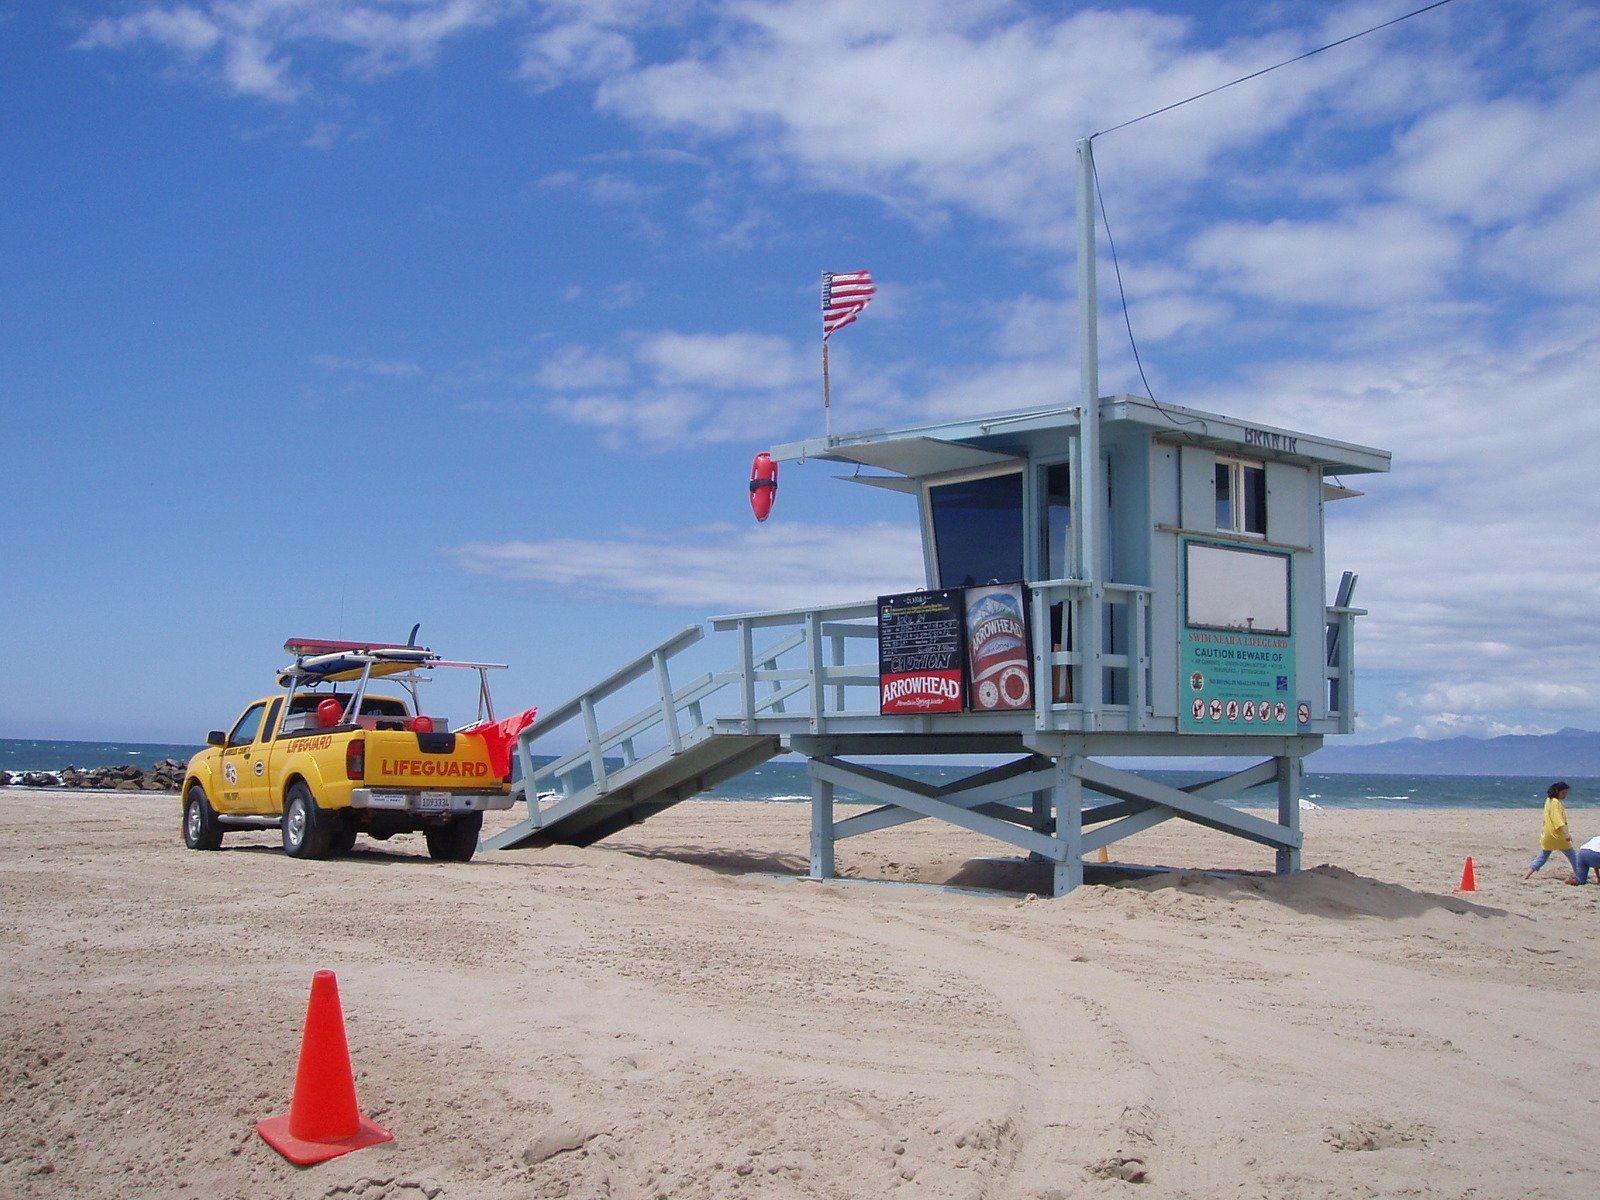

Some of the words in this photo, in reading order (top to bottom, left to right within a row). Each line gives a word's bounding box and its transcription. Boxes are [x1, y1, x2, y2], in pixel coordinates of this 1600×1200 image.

[972, 619, 1023, 655] ARROWHEAD
[1188, 633, 1212, 643] SWIM
[1214, 635, 1235, 645] NEAR
[1244, 637, 1288, 649] LIFEGUARD
[1194, 647, 1235, 659] CAUTION
[1236, 650, 1270, 661] BEWARE
[1272, 653, 1283, 662] OF
[882, 676, 960, 706] ARROWHEAD
[287, 735, 332, 754] LIFEGUARD
[381, 759, 488, 777] LIFEGUARD
